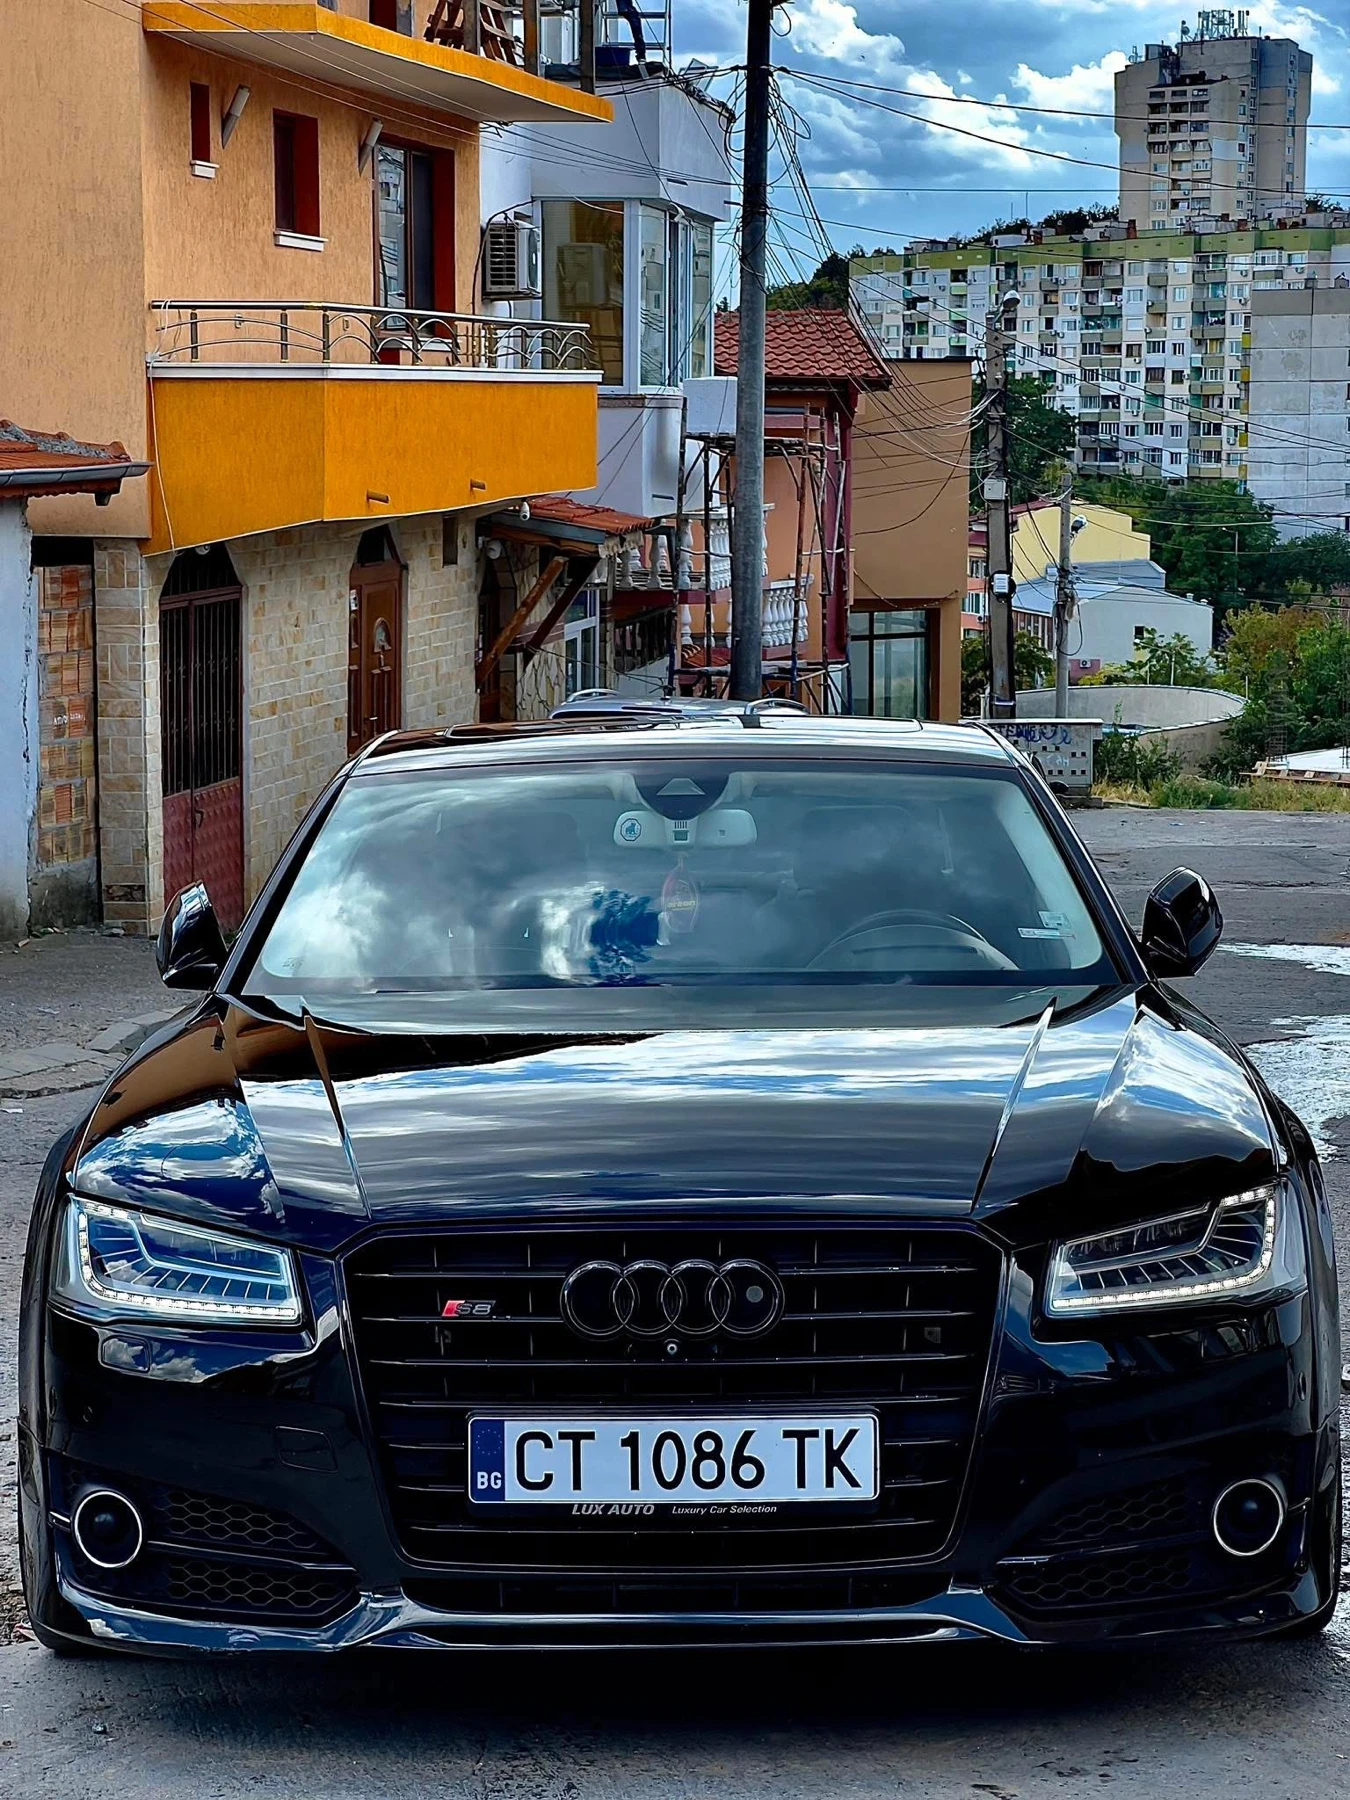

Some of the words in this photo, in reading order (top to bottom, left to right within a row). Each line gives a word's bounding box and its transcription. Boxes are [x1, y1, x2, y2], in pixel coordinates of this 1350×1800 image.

[455, 1303, 492, 1315] S8
[516, 1430, 596, 1491] CT
[620, 1429, 766, 1491] 1086
[782, 1428, 863, 1490] TK
[476, 1471, 502, 1490] BG
[571, 1504, 605, 1515] LUX
[607, 1504, 655, 1515] AUTO
[671, 1505, 707, 1516] Luxury
[709, 1505, 728, 1514] Car
[729, 1504, 777, 1514] Selection
